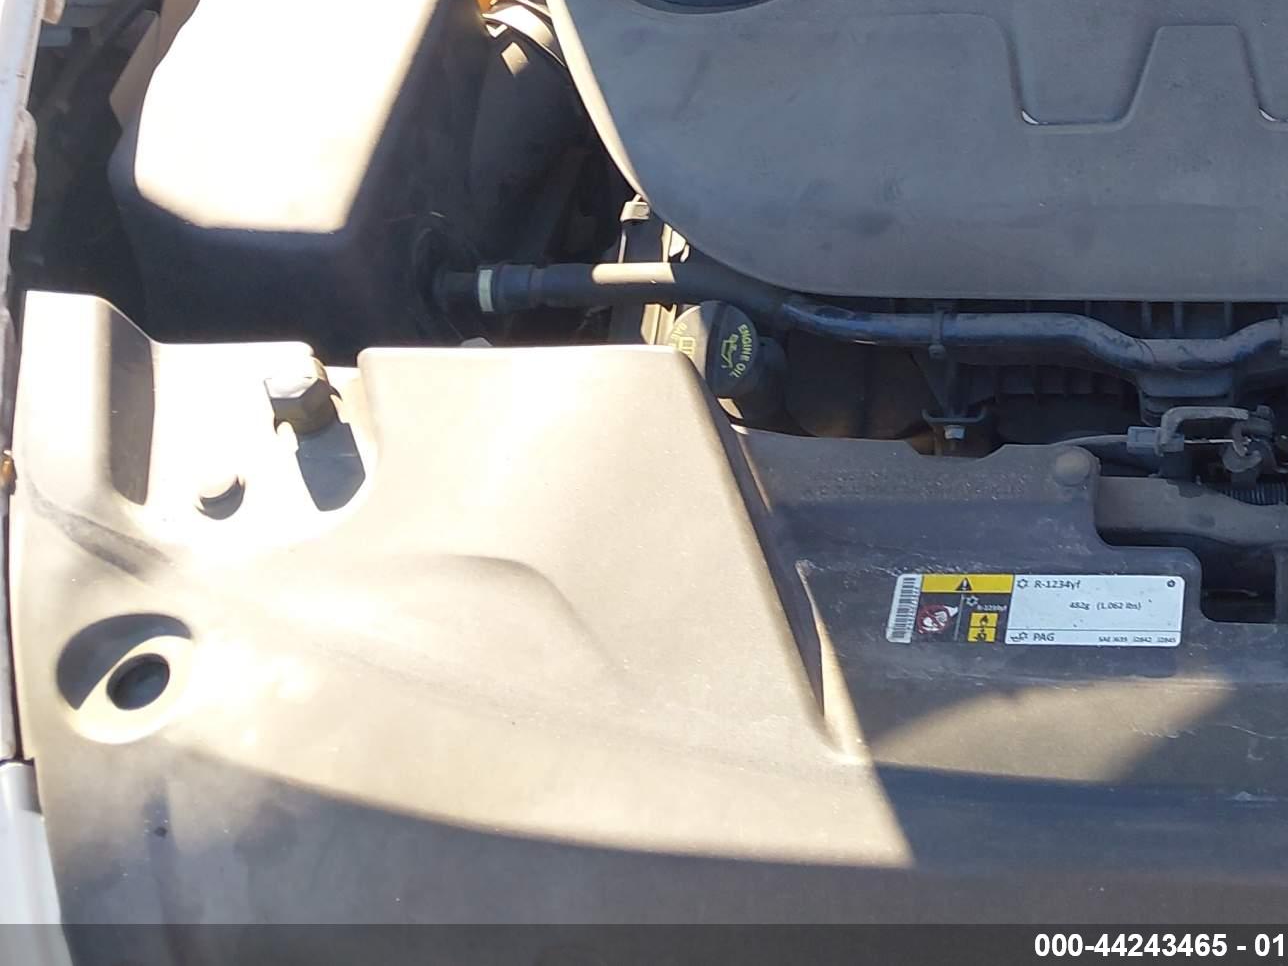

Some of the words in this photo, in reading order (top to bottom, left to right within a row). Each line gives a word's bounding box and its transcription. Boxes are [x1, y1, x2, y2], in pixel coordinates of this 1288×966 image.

[737, 324, 753, 362] ENGINE
[729, 363, 746, 378] OIL
[1034, 580, 1081, 590] R-1234yf
[1033, 632, 1055, 642] PAG
